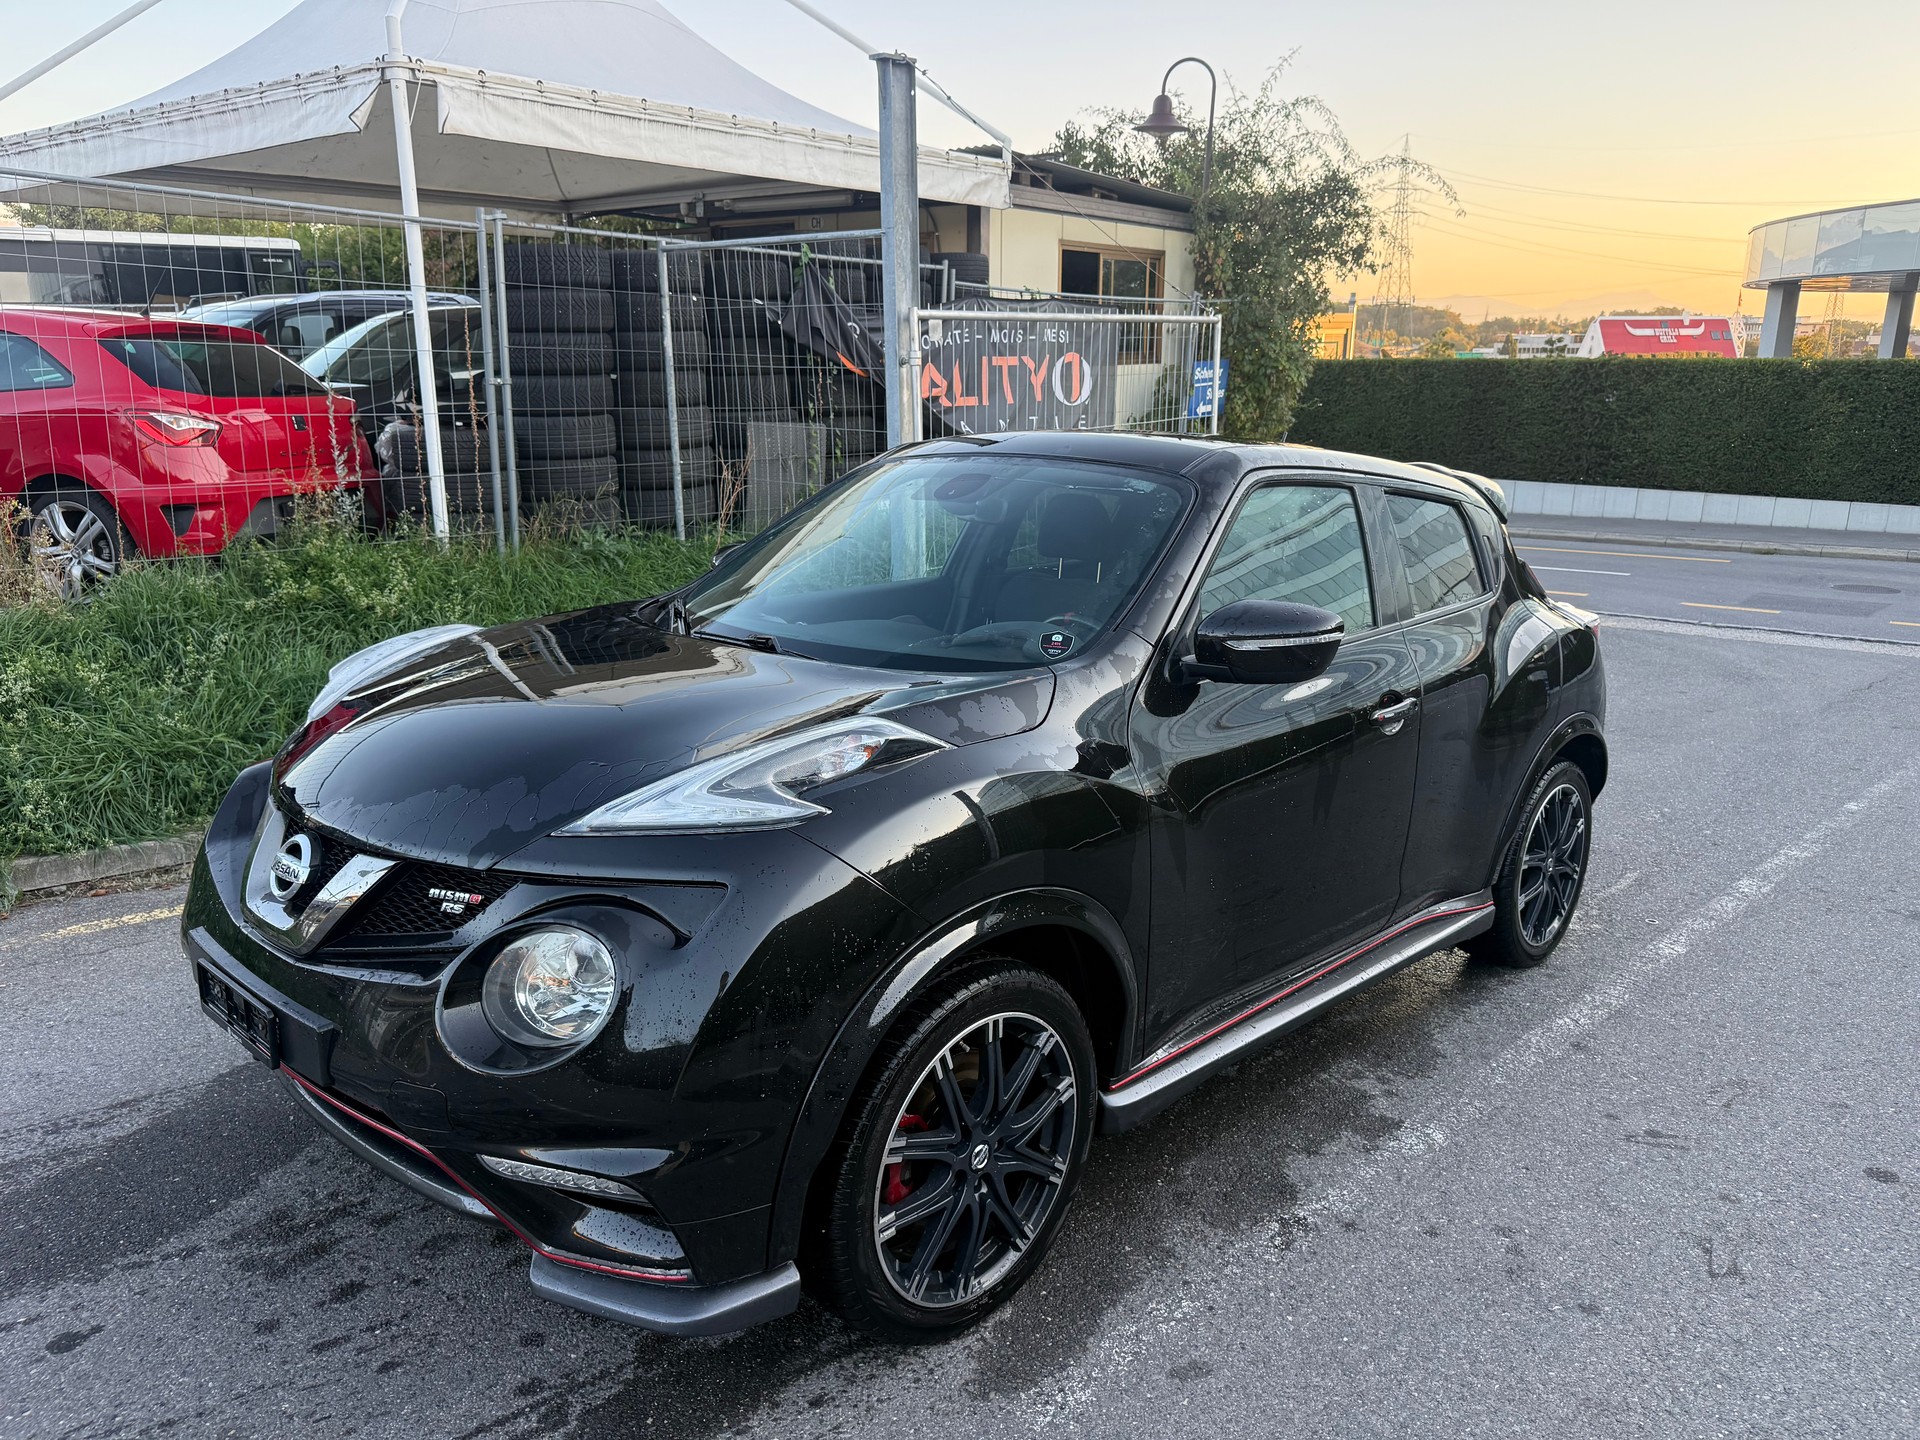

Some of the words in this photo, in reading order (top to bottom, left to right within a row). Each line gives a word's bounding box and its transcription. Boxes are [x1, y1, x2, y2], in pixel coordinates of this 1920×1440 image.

[811, 216, 821, 229] CH
[990, 328, 1024, 344] MOIS
[1042, 328, 1070, 344] MESI
[440, 902, 465, 914] RS
